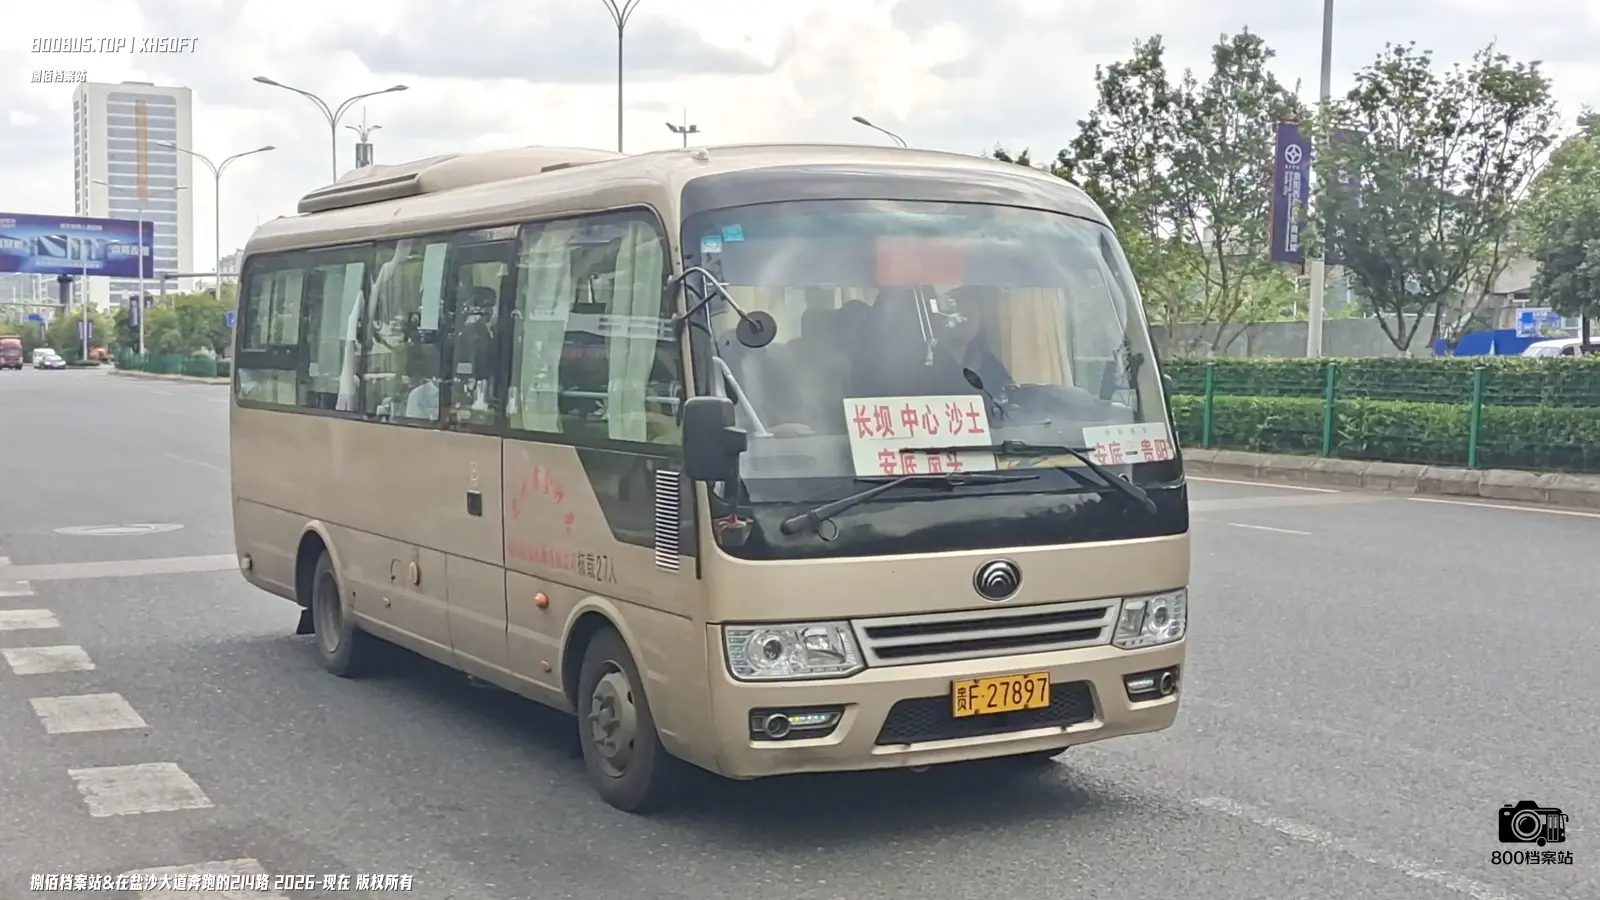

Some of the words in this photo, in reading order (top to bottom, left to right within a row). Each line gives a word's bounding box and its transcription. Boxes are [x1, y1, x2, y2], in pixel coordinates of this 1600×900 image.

[853, 403, 895, 439] 长坝
[900, 402, 940, 437] 中心
[945, 401, 985, 435] 沙土
